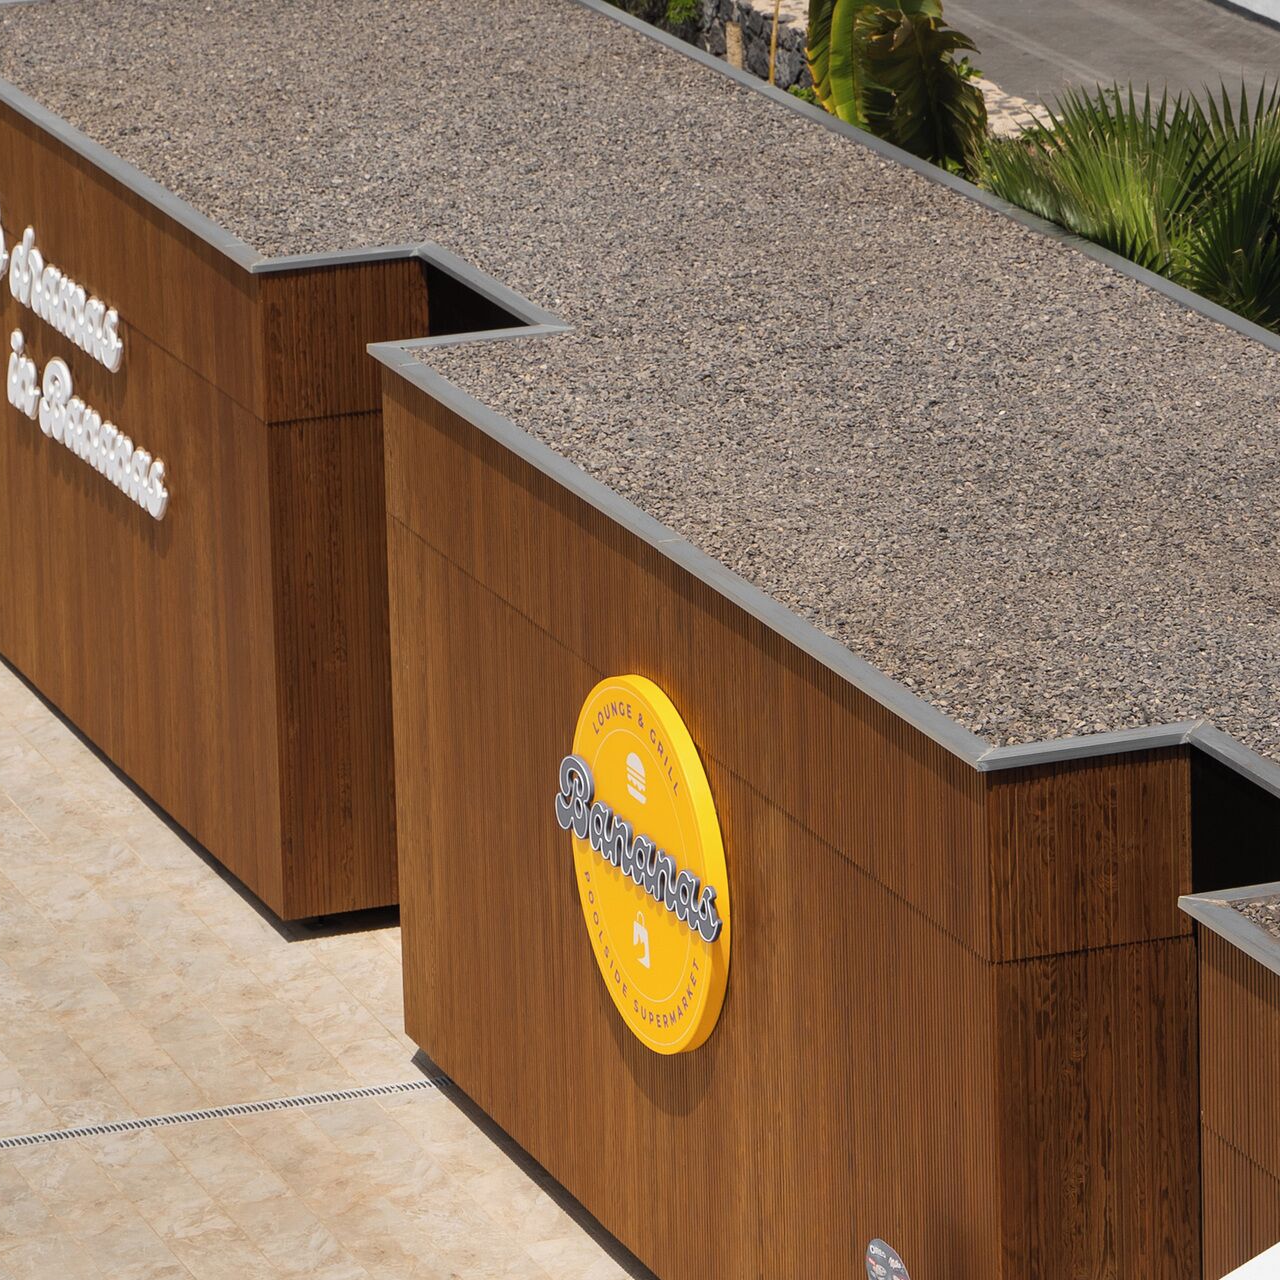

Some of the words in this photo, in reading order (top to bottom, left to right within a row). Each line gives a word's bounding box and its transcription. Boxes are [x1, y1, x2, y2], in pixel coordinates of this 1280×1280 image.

[8, 225, 122, 373] dramas
[7, 328, 40, 420] in
[38, 356, 168, 521] Bananas
[592, 702, 632, 735] LOUNGE
[637, 713, 644, 729] &
[650, 729, 678, 797] GRILL
[555, 755, 722, 942] Bananas
[584, 871, 627, 998] POOLSIDE
[634, 958, 699, 1029] SUPERMARKET
